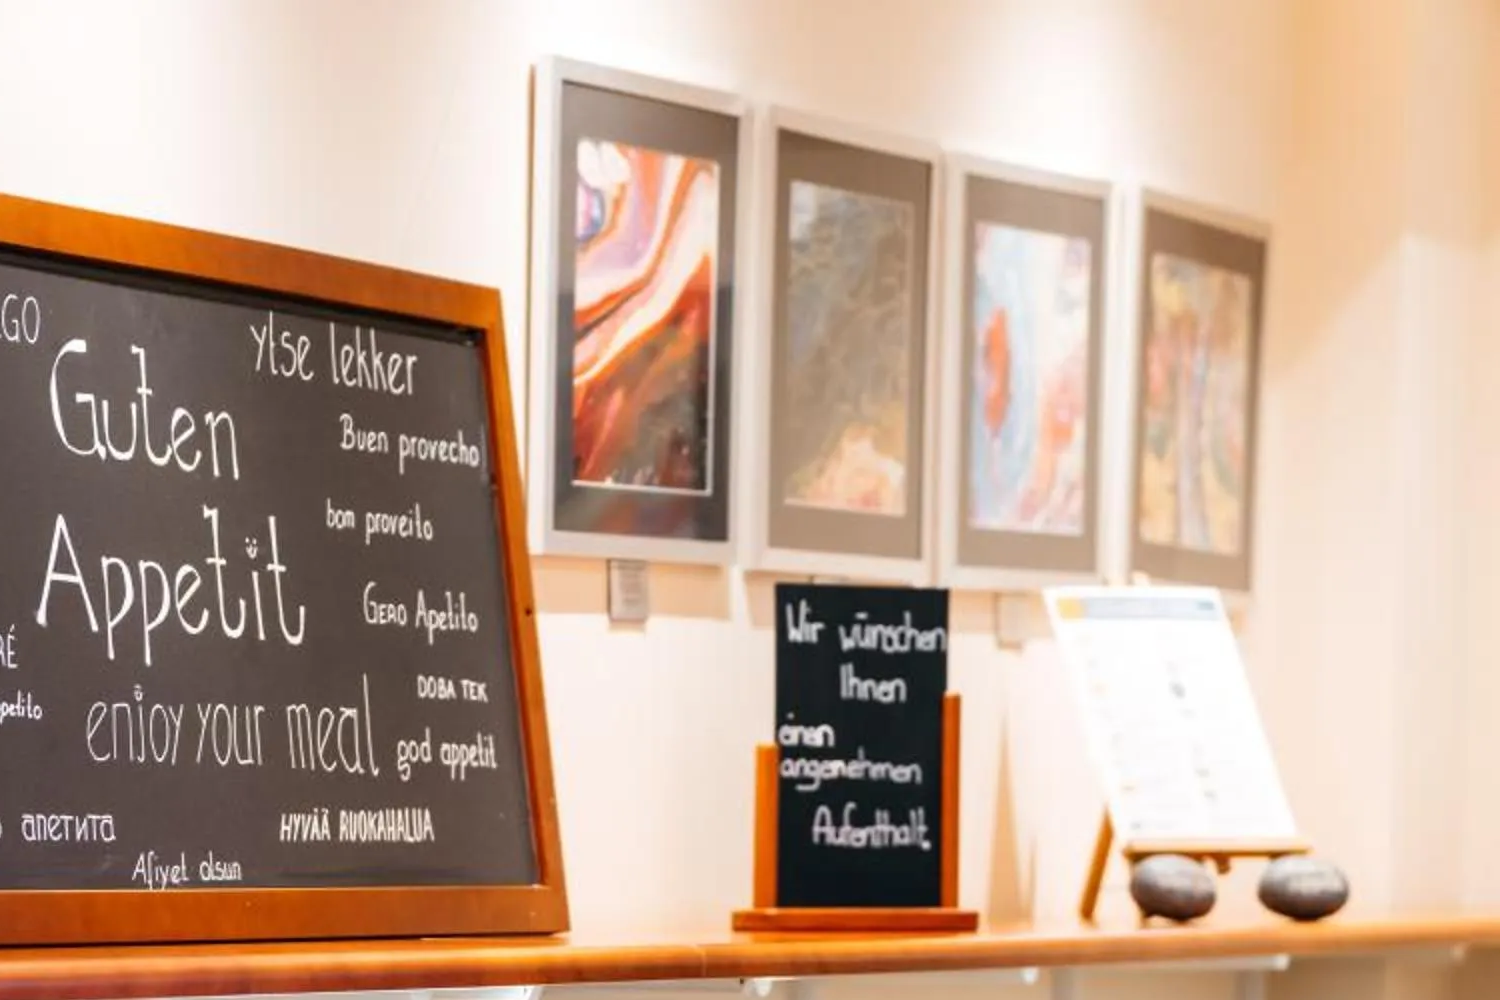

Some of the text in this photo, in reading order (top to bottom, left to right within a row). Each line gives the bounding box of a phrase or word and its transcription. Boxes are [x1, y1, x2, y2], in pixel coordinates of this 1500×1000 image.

[329, 321, 418, 396] lekker
[49, 338, 240, 480] Guten
[339, 412, 480, 475] Buen provecho
[365, 502, 434, 546] proveito
[35, 503, 306, 666] Appetit
[415, 589, 479, 646] Apetito
[838, 610, 947, 653] wünschen
[417, 674, 489, 703] DOBA TEK
[839, 661, 907, 703] Ihnen
[86, 673, 380, 776] enjoy your meal
[397, 726, 498, 782] god appetit
[21, 812, 117, 842] апетита
[279, 807, 435, 843] HYVÄÄ RUOKAHALUA
[132, 850, 242, 891] Afiyet olsun
